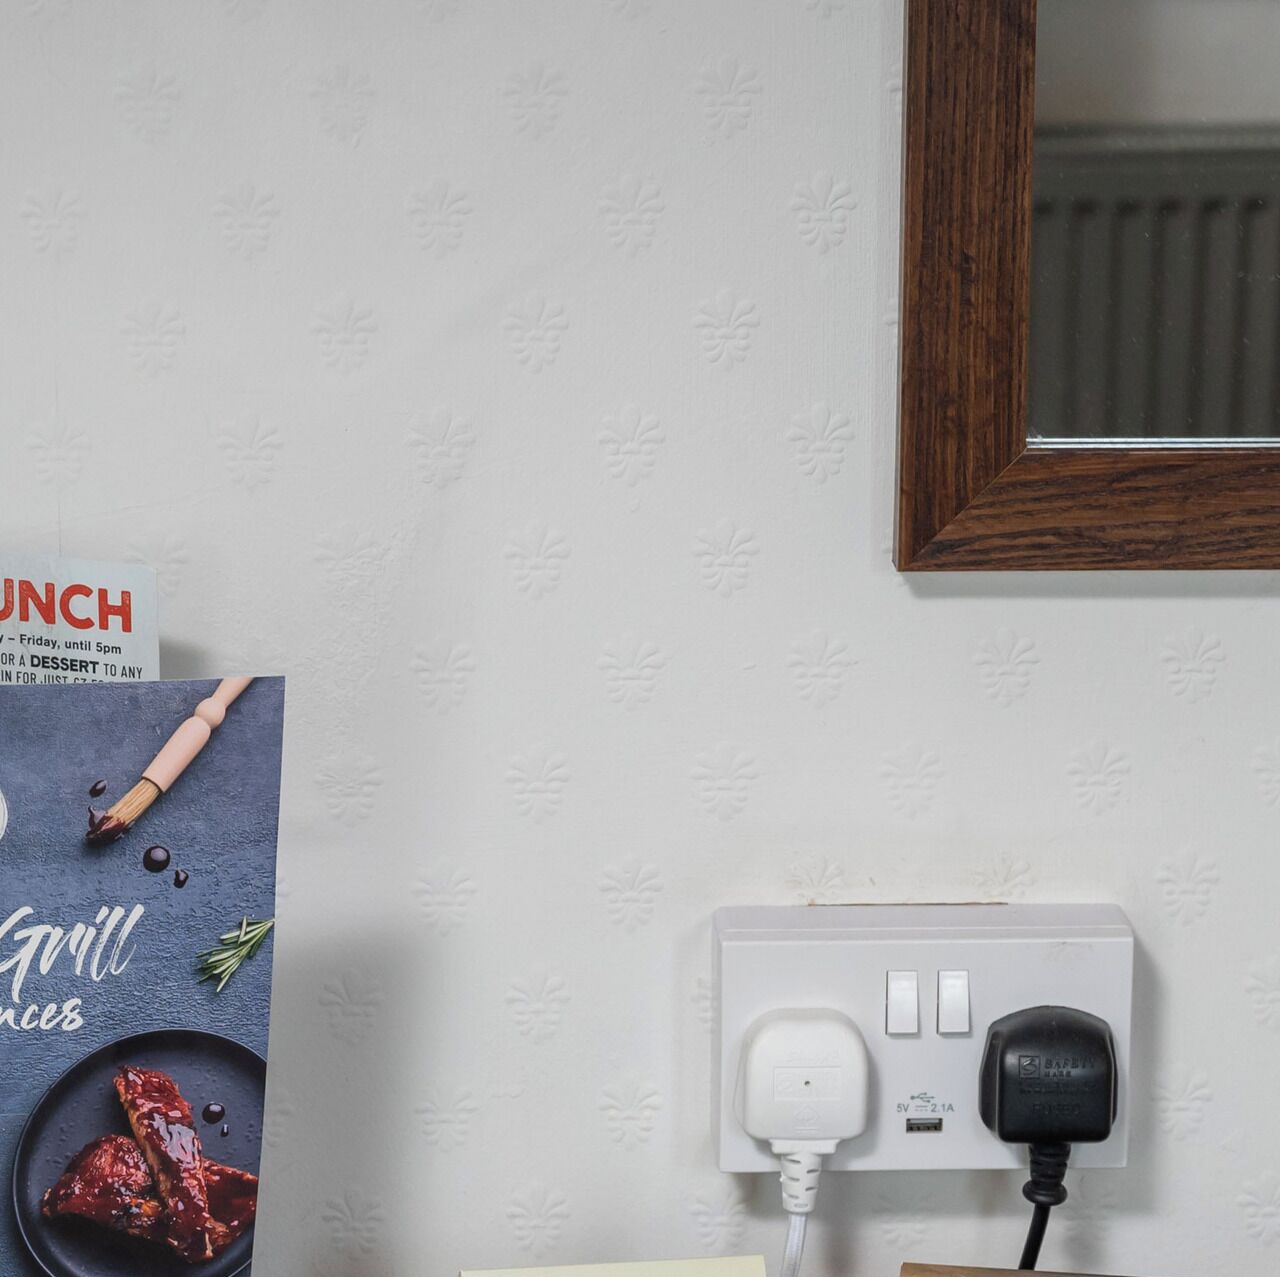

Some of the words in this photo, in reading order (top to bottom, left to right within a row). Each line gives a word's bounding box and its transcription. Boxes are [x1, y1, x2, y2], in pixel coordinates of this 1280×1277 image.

[64, 640, 91, 651] until
[96, 642, 121, 655] 5pm
[1, 652, 14, 664] OR
[19, 655, 25, 666] A
[30, 654, 99, 673] DESSERT
[104, 663, 116, 676] TO
[121, 666, 142, 678] ANY
[16, 671, 36, 684] FOR
[897, 1103, 910, 1112] 5V
[931, 1103, 955, 1112] 2.1A
